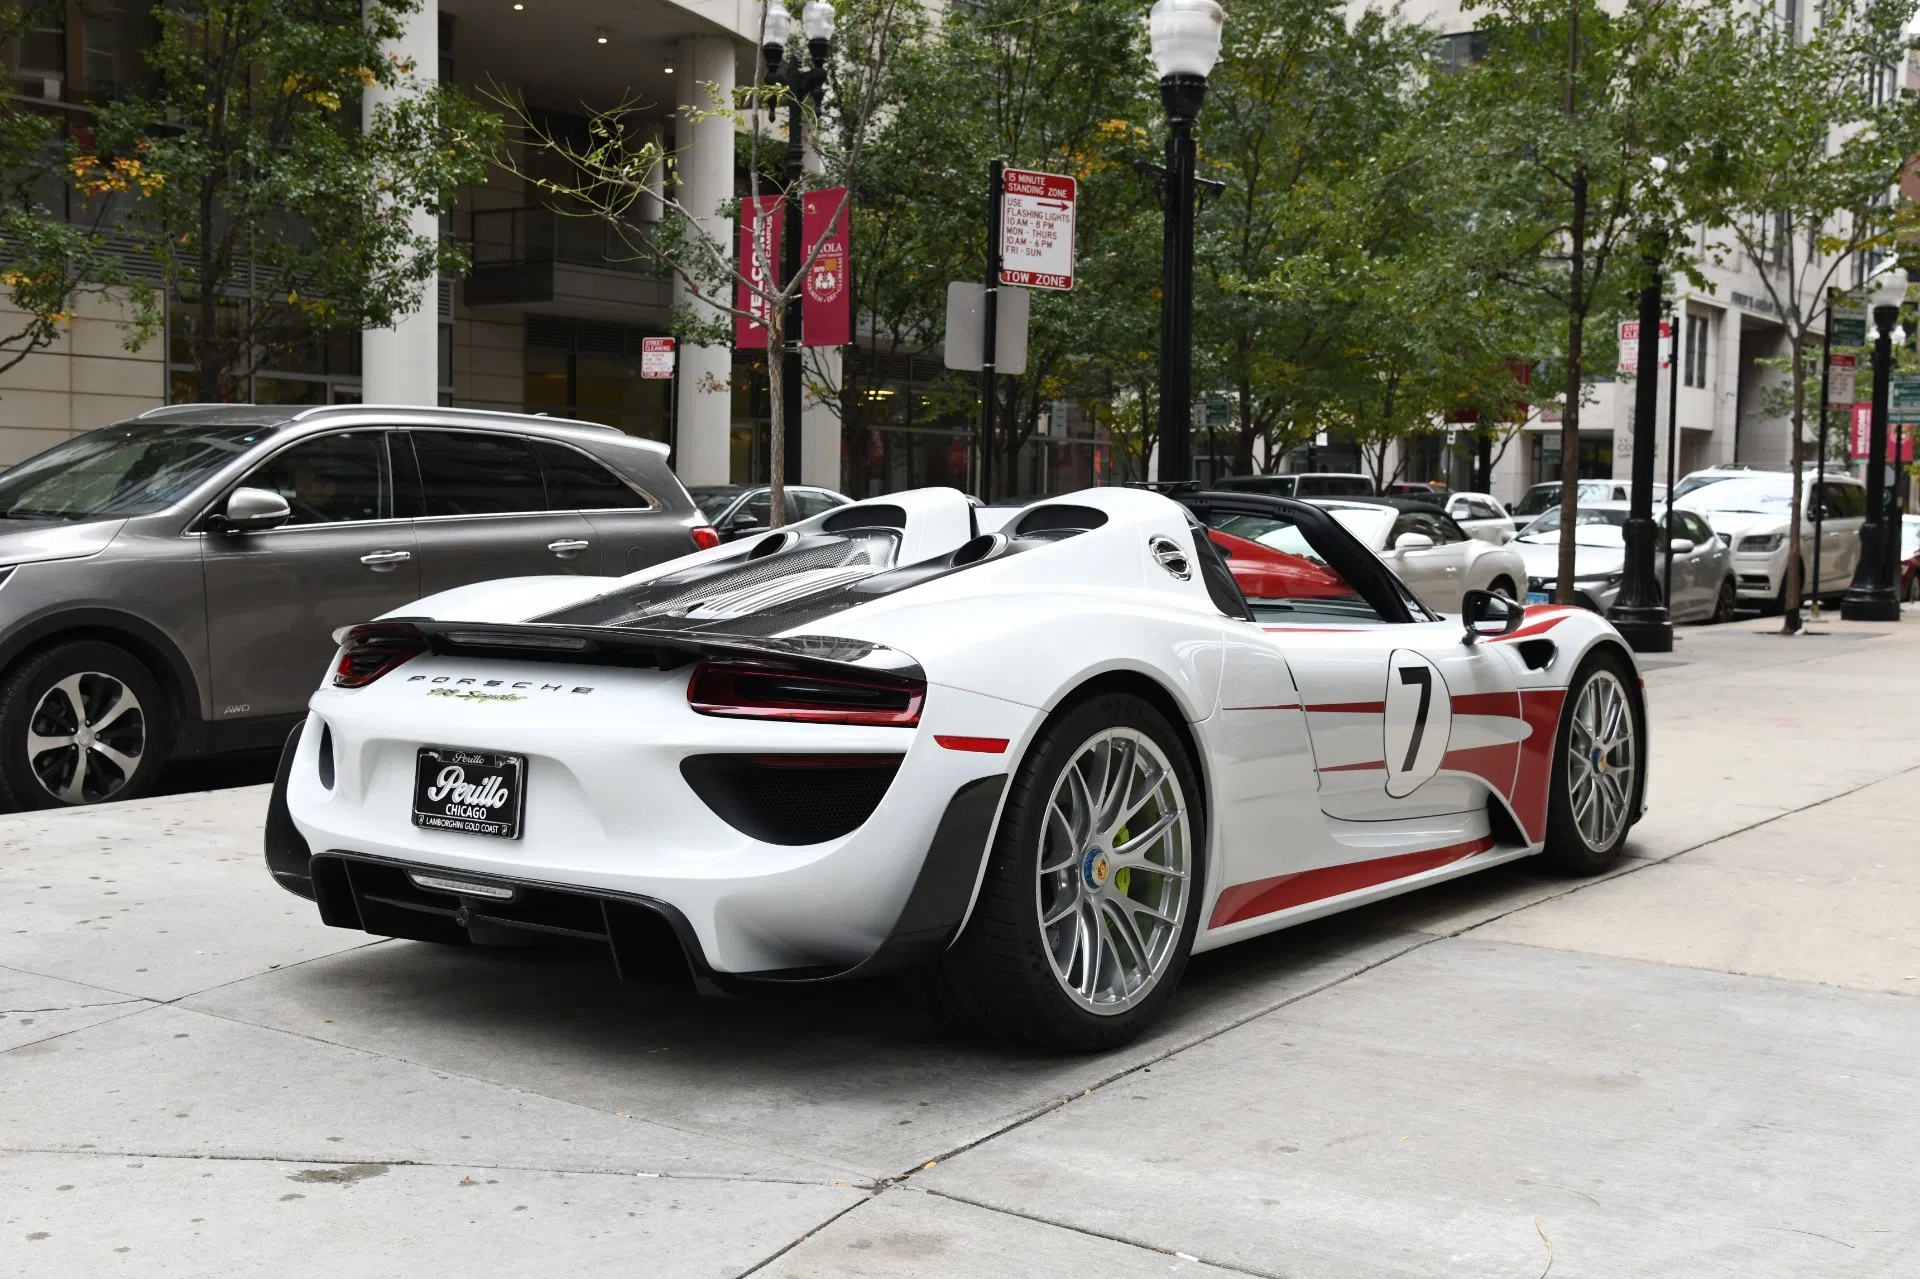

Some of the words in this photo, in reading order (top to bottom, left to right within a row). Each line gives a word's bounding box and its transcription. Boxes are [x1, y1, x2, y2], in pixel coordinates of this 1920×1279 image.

[1008, 173, 1016, 181] 15
[1018, 174, 1046, 186] MINUTE
[1008, 183, 1044, 196] STANDING
[1048, 189, 1067, 198] ZONE
[1007, 198, 1022, 207] USE
[1007, 208, 1043, 219] FLASHING
[1045, 212, 1070, 222] LIGHTS
[1007, 217, 1015, 225] 10
[1017, 218, 1028, 226] AM
[1035, 220, 1041, 228] 8
[1042, 221, 1054, 229] PM
[1007, 227, 1023, 236] MON
[1032, 229, 1057, 240] THURS
[808, 242, 842, 254] LOLA
[1041, 240, 1053, 249] PM
[1005, 246, 1018, 254] FRI
[1026, 248, 1042, 257] SUN
[1005, 270, 1030, 284] TOW
[1035, 274, 1066, 288] ZONE
[407, 675, 594, 695] PORSCHE
[224, 704, 250, 714] AWD
[1398, 666, 1432, 772] 7
[452, 752, 485, 764] Perillo
[427, 765, 508, 809] Perillo
[445, 804, 487, 819] CHICAGO
[426, 818, 464, 829] LAMBORGHINI
[465, 822, 480, 832] GOLD
[481, 824, 499, 834] COAST
